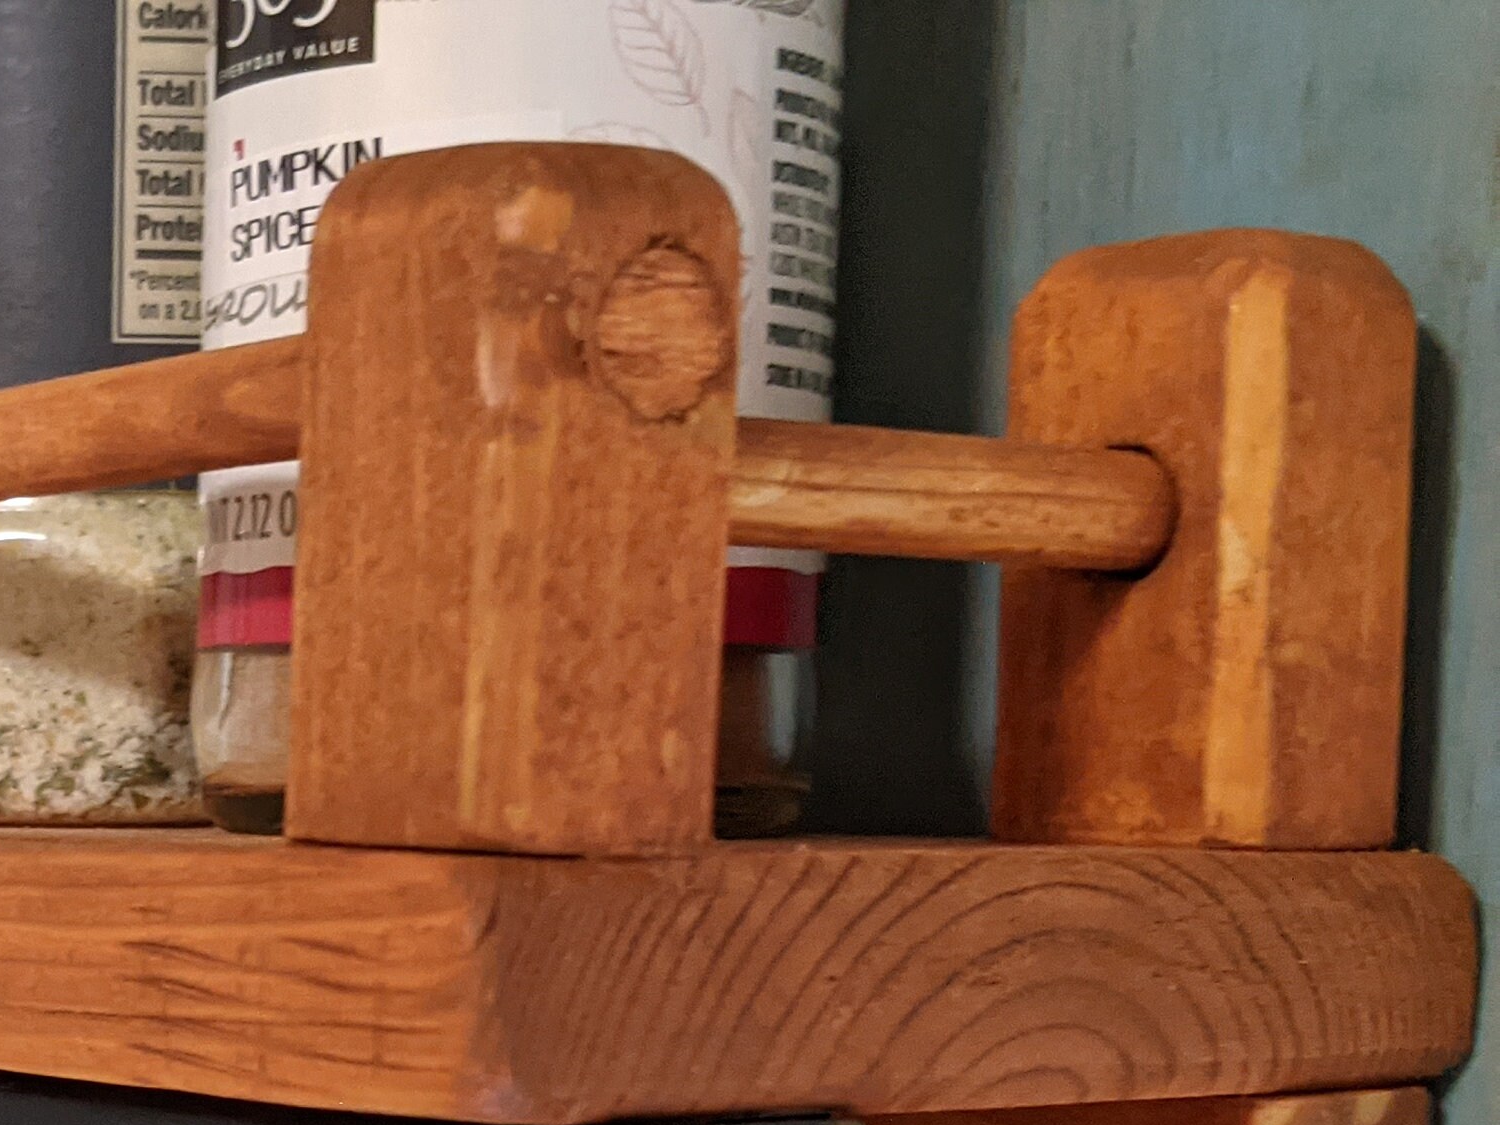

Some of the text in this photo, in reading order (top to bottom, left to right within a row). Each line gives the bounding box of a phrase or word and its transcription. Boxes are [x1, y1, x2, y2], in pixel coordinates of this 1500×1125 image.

[292, 36, 360, 61] VALUE
[137, 79, 195, 107] Total
[136, 168, 192, 196] Total
[230, 136, 383, 208] PUMPKIN
[230, 205, 322, 263] SPICE
